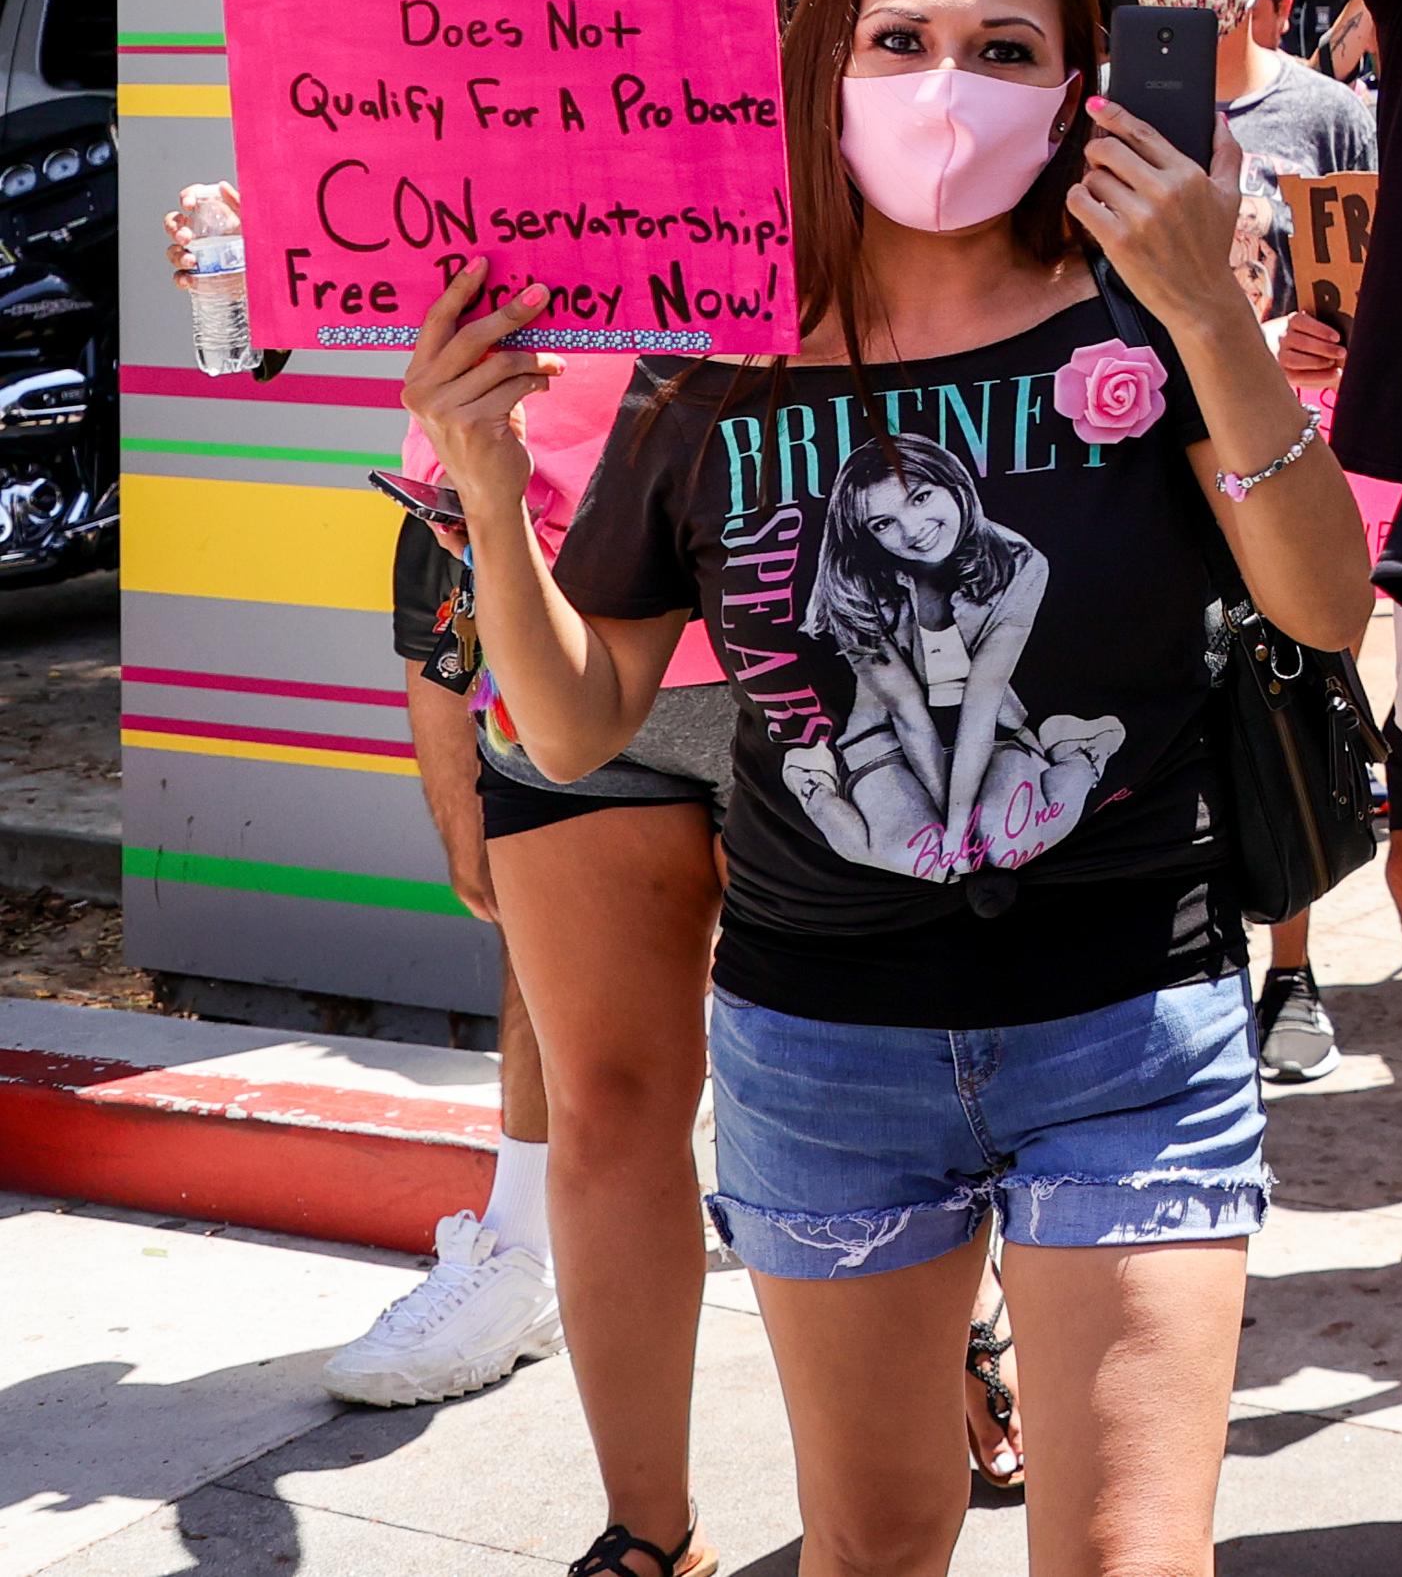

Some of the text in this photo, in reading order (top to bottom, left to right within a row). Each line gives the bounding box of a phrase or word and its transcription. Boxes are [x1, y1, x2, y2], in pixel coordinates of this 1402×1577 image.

[289, 72, 779, 140] Qualify For A Probate
[284, 247, 399, 314] Free
[648, 259, 779, 330] Now!
[717, 372, 1108, 519] BRITNE
[720, 503, 834, 746] SPEARS
[907, 803, 996, 879] Baby
[1004, 781, 1066, 840] One
